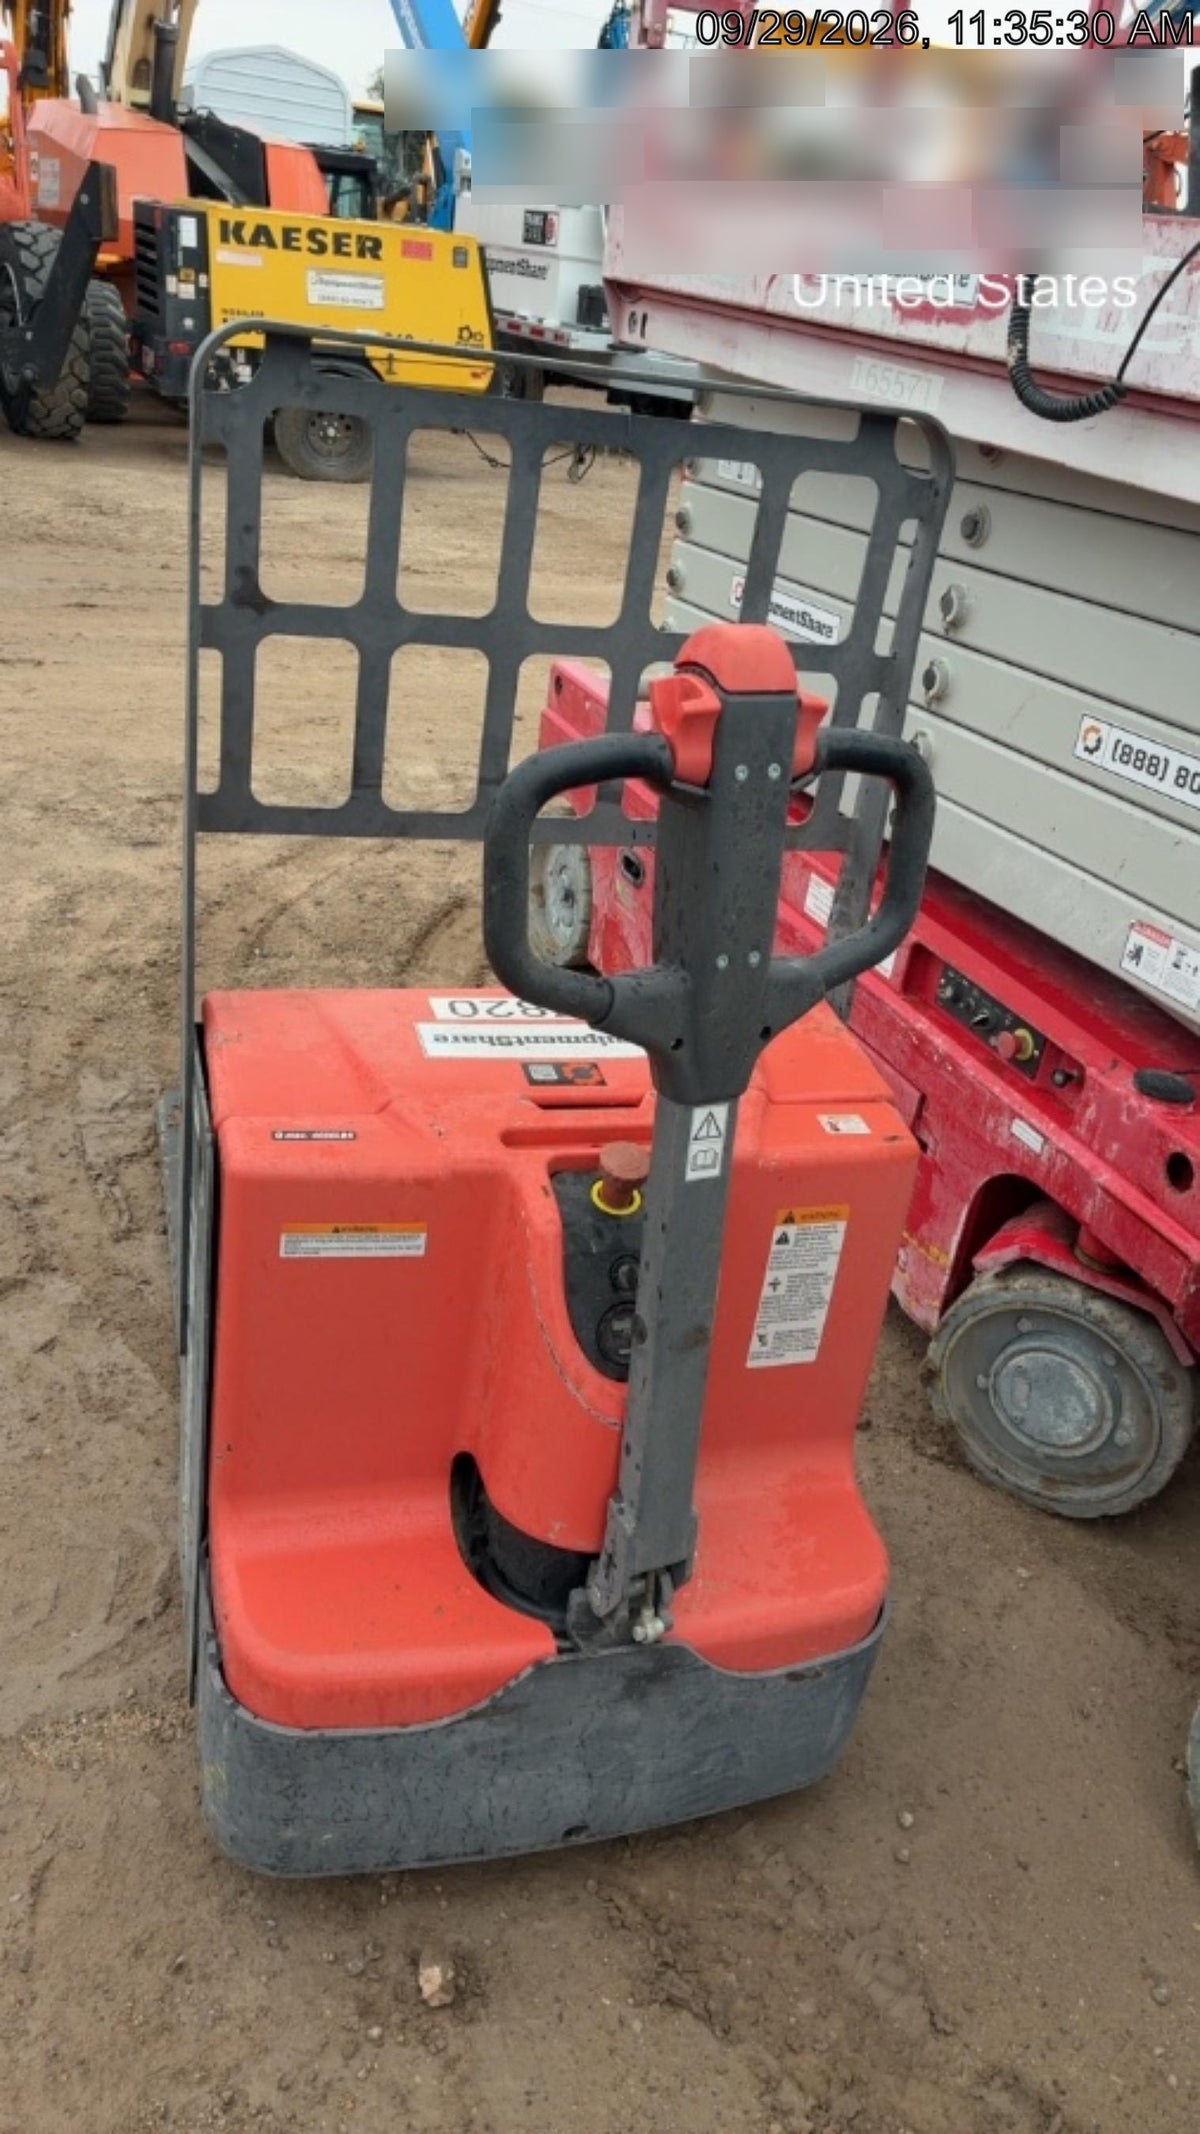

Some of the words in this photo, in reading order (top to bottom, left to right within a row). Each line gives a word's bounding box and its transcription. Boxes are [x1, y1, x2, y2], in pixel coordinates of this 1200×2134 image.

[219, 219, 383, 261] KAESER
[1111, 738, 1170, 783] (888)
[1173, 765, 1200, 795] 80
[449, 999, 569, 1018] 820
[433, 1032, 626, 1047] uipmentShare
